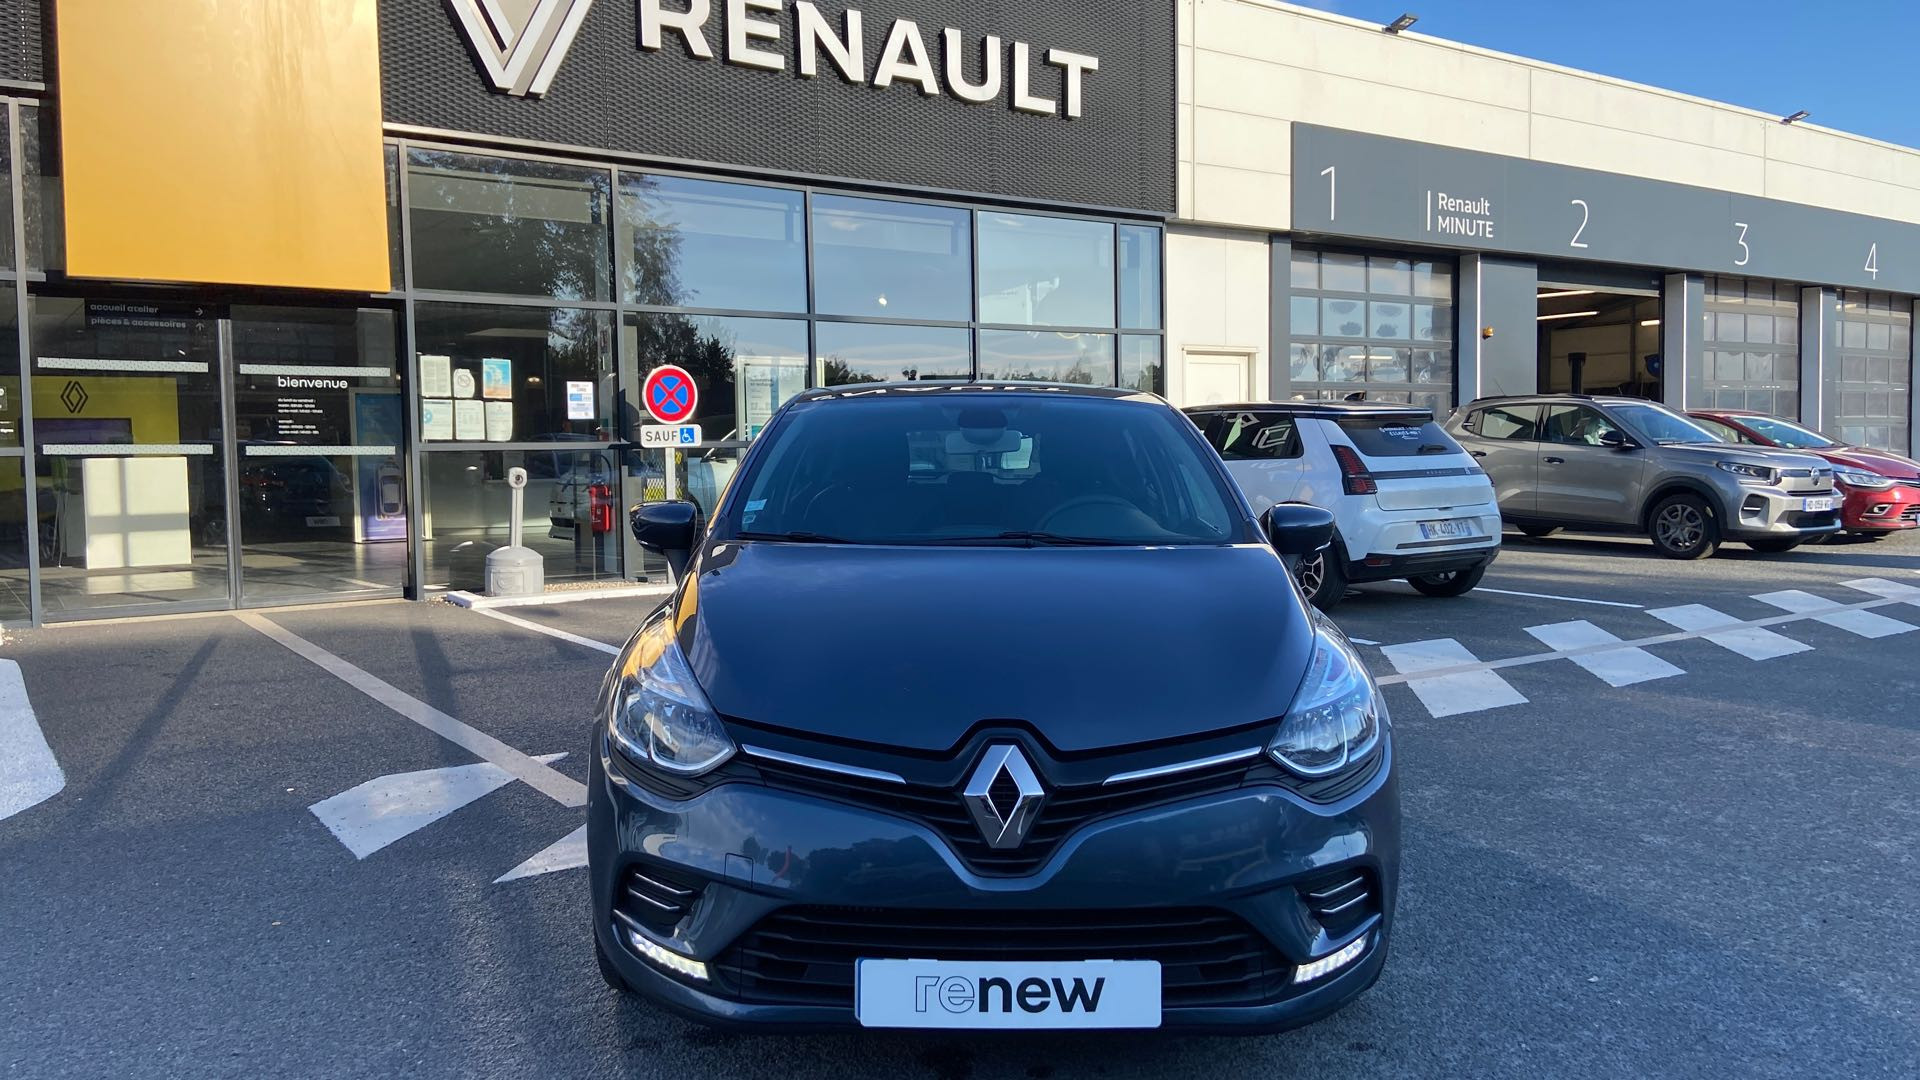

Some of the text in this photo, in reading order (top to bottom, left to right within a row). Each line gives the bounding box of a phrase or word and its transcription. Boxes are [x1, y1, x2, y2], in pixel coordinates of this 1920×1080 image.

[639, 0, 1099, 118] RENAULT
[1320, 166, 1335, 221] 1
[1437, 192, 1491, 216] Renault
[1437, 215, 1494, 238] MINUTE
[1570, 199, 1589, 249] 2
[1734, 222, 1749, 266] 3
[1864, 242, 1879, 281] 4
[90, 304, 159, 313] accueil atelier
[91, 317, 122, 325] pièces
[131, 320, 187, 328] accessoires
[277, 375, 348, 389] bienvenue
[645, 430, 678, 442] SAUF
[914, 975, 1106, 1014] renew
